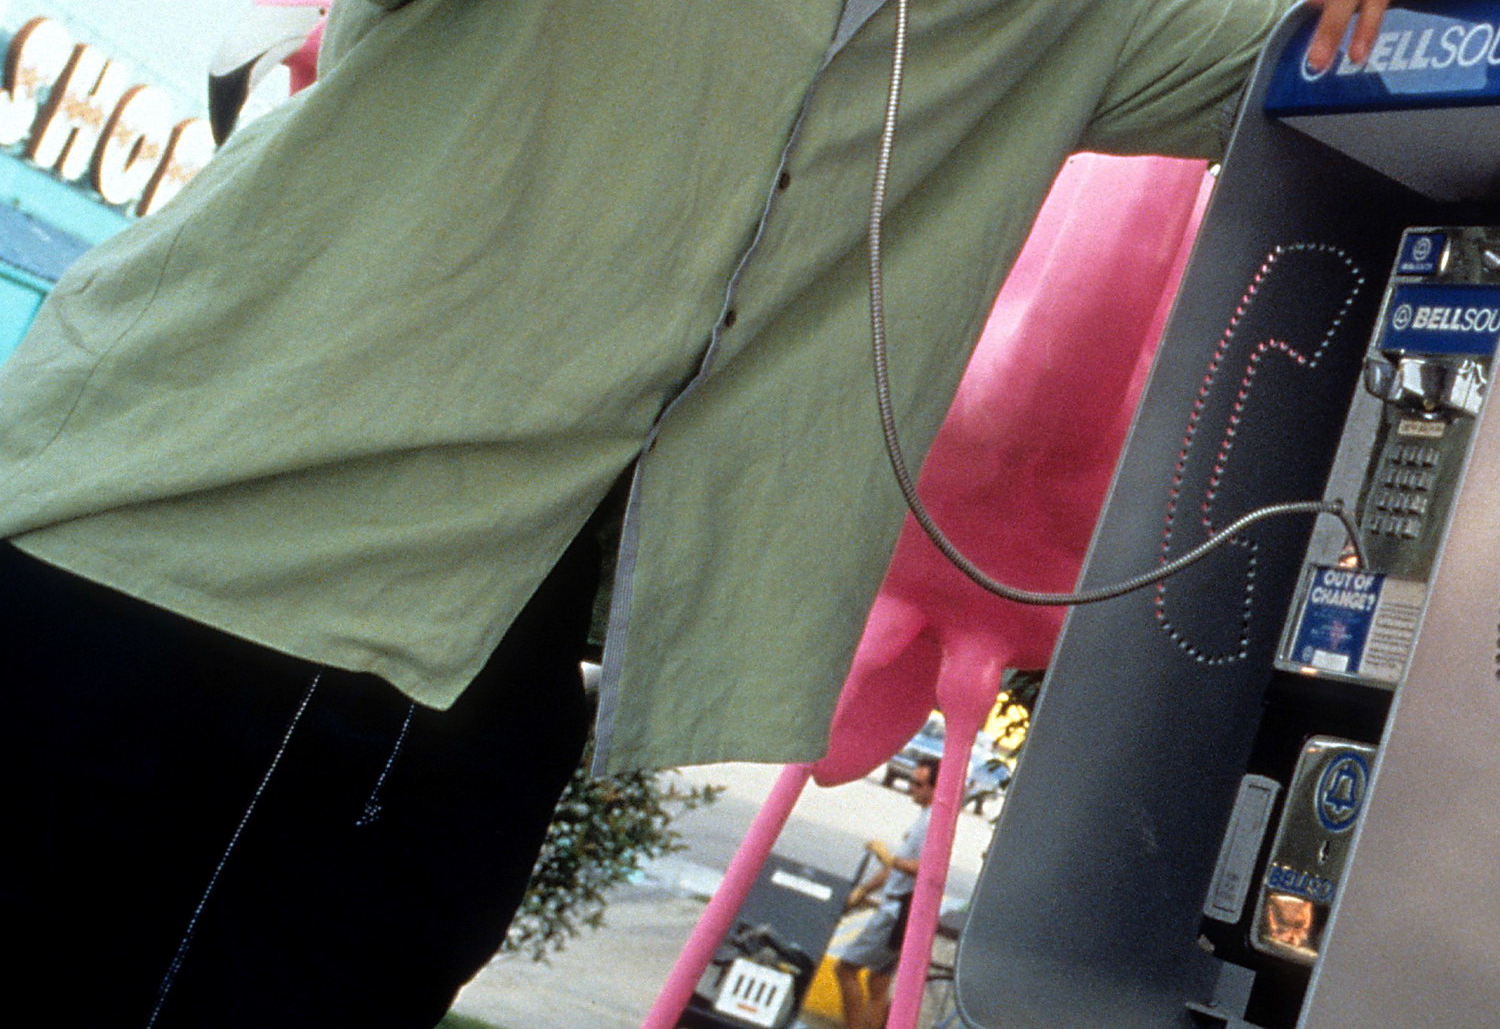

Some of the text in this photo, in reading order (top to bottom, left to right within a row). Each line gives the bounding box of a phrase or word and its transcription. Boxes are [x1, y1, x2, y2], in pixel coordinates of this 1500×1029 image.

[1323, 571, 1375, 591] OUT OF
[1311, 586, 1377, 610] CHANGE?
